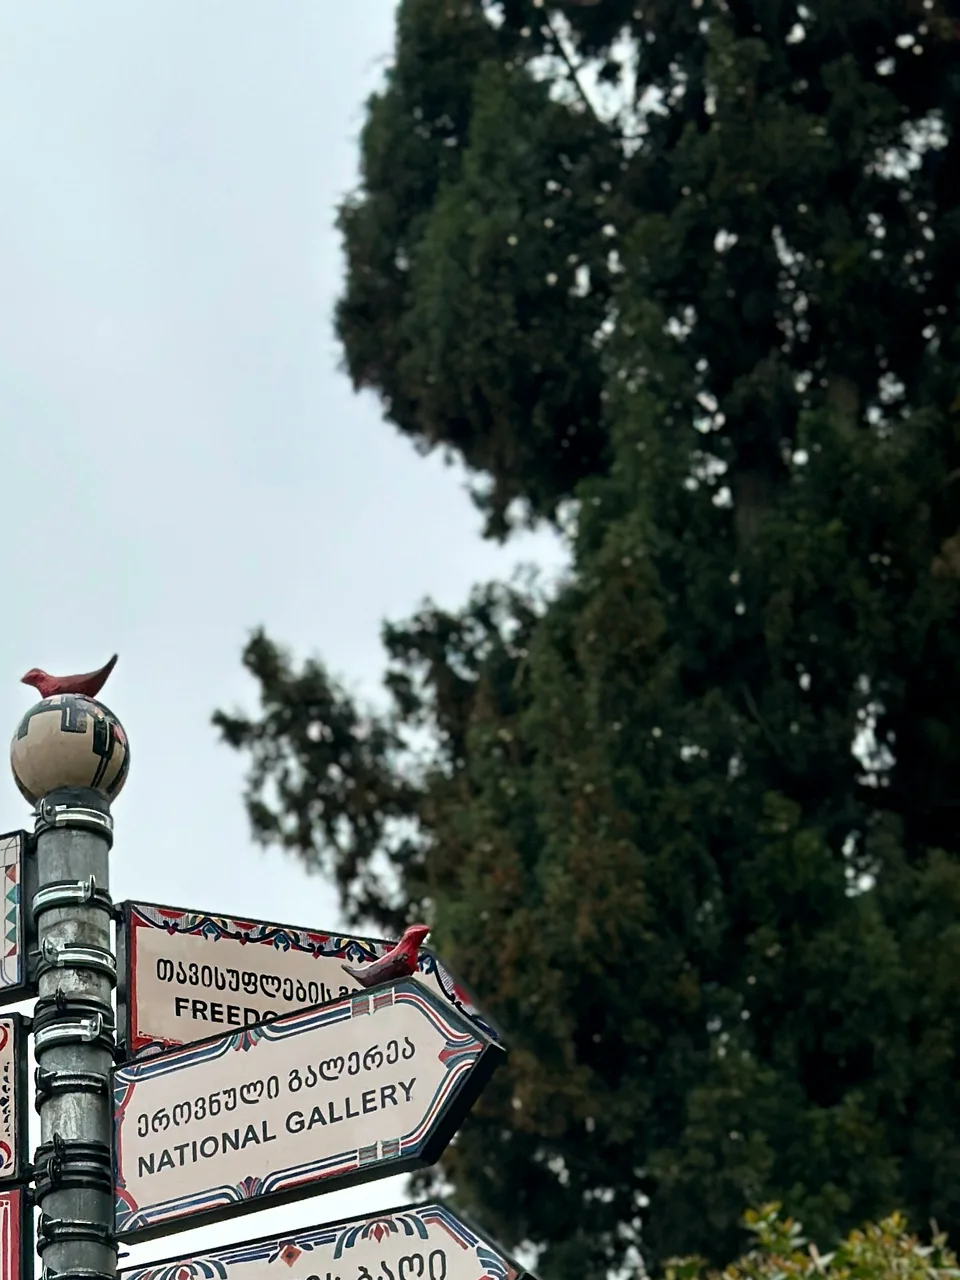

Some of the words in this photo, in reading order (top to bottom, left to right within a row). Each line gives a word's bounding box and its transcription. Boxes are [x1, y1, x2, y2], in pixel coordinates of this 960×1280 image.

[156, 958, 332, 1004] თავისუფლების
[174, 996, 279, 1027] FREED
[137, 1075, 280, 1138] ეროვნული
[288, 1036, 416, 1092] გალერეა
[138, 1120, 277, 1177] NATIONAL
[285, 1077, 417, 1134] GALLERY
